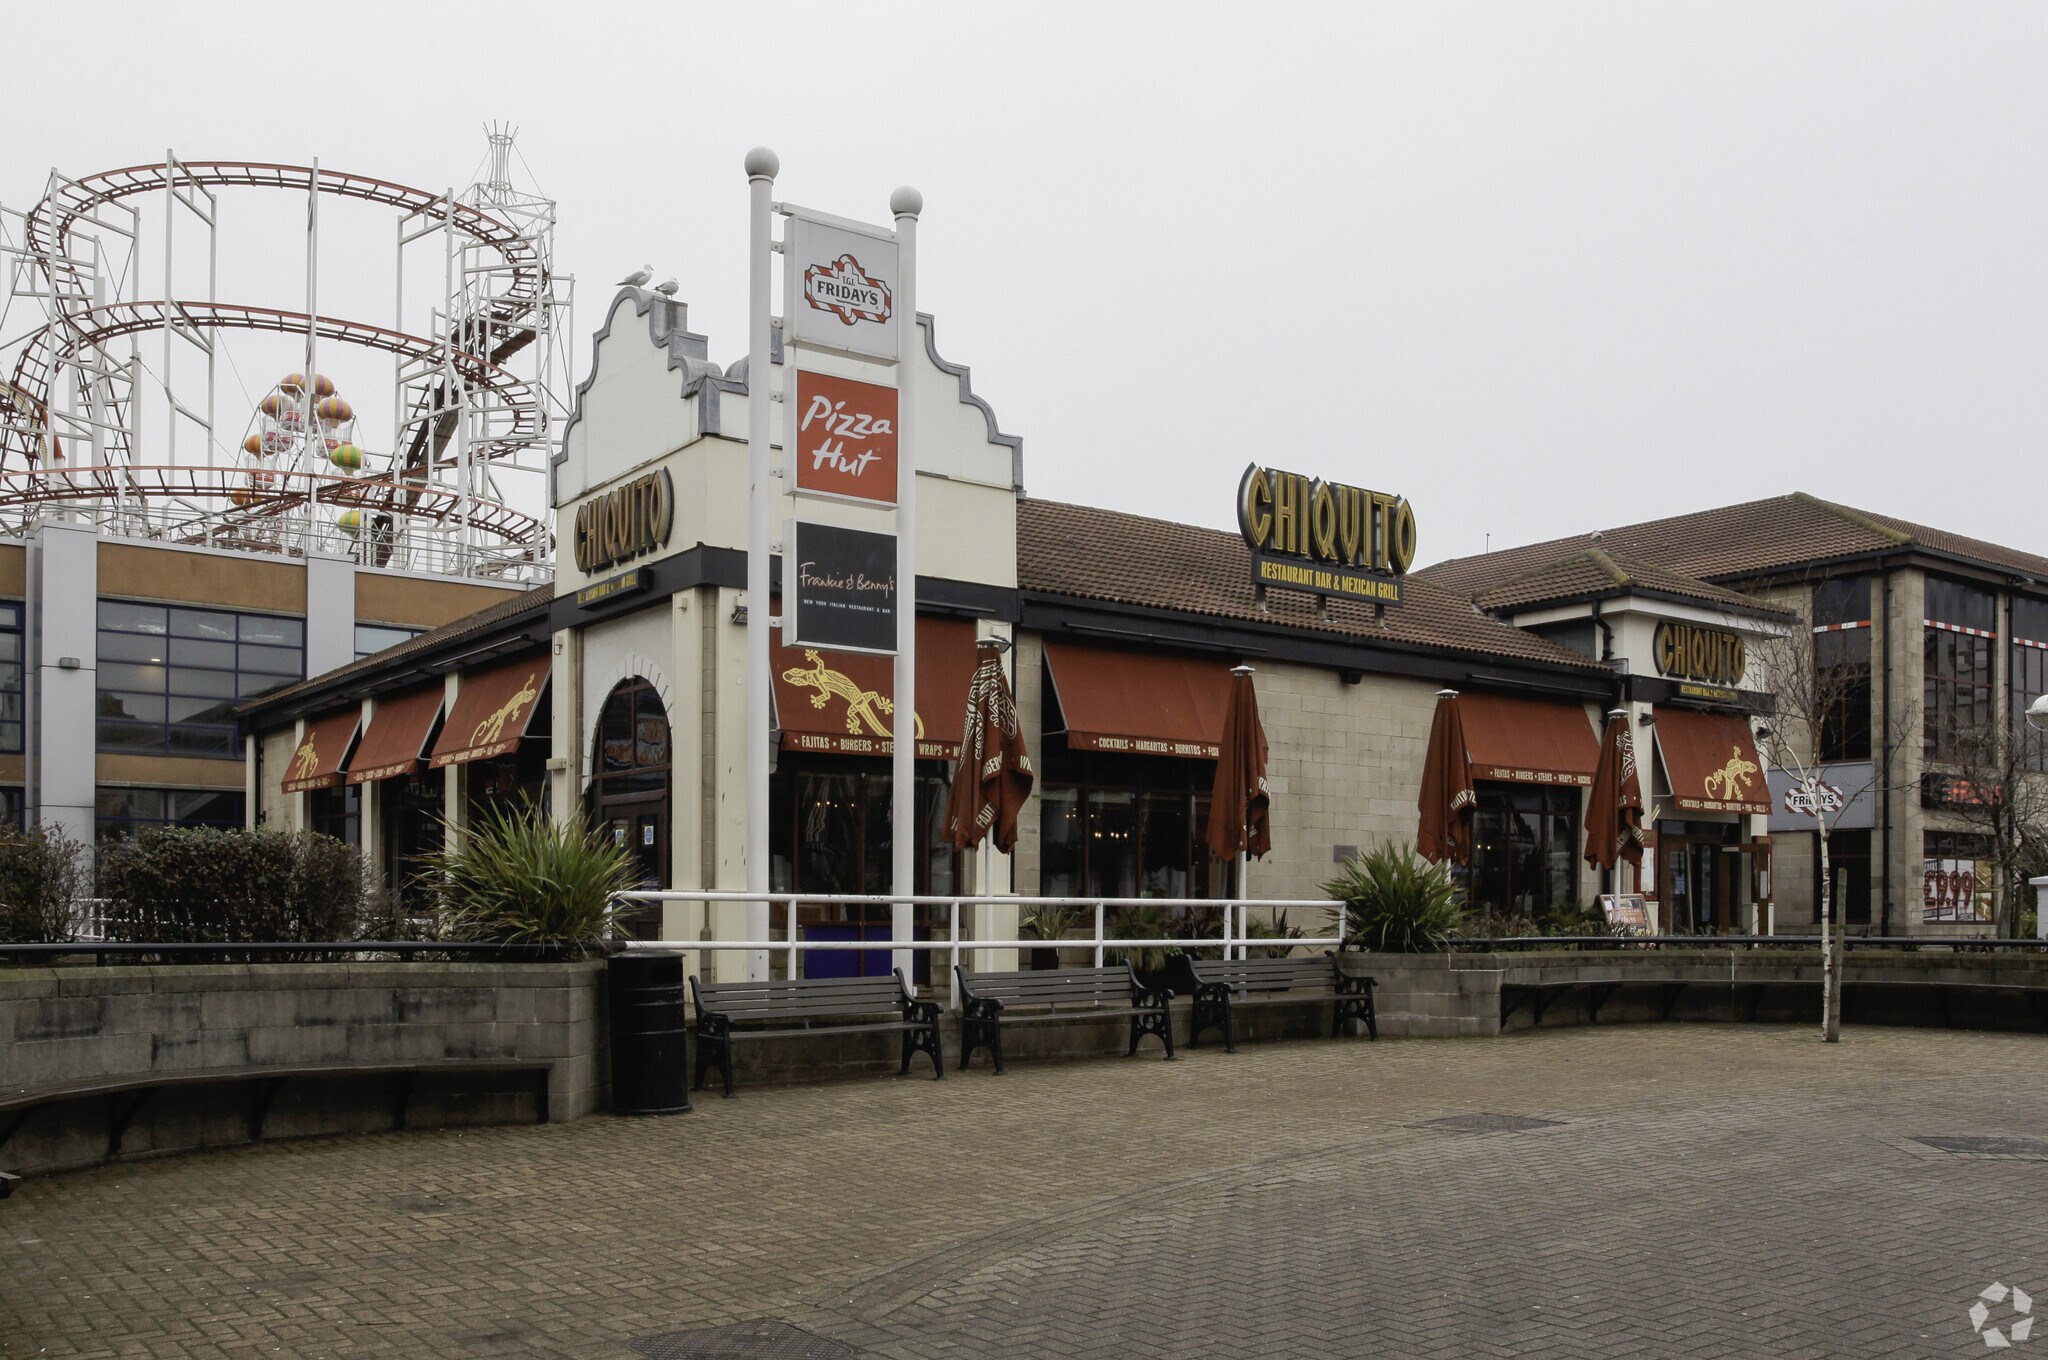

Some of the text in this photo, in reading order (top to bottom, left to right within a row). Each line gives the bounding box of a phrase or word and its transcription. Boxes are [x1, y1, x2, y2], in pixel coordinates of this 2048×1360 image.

[816, 280, 879, 306] FRIDAY'S
[801, 395, 893, 440] Pizza
[812, 437, 882, 477] Hut
[574, 467, 672, 574] CHIQUITO
[1245, 464, 1417, 575] CHIQUITO
[799, 561, 844, 589] Frankie
[857, 573, 895, 598] Benny's
[1261, 561, 1399, 601] RESTAURANT BAR & MEXICAN GRILL
[848, 604, 875, 612] RESTAURANT
[1656, 621, 1746, 685] CHIQUITO
[801, 735, 830, 749] FAJITAS
[840, 738, 872, 752] BURGERS
[881, 741, 894, 754] STE
[918, 743, 943, 757] WRAPS
[1098, 737, 1129, 750] COCKTAILS
[1135, 739, 1168, 753] MARGARITAS
[1175, 743, 1201, 756] BURRITOS
[976, 801, 997, 829] FAJIT
[1793, 794, 1834, 806] FRiYS
